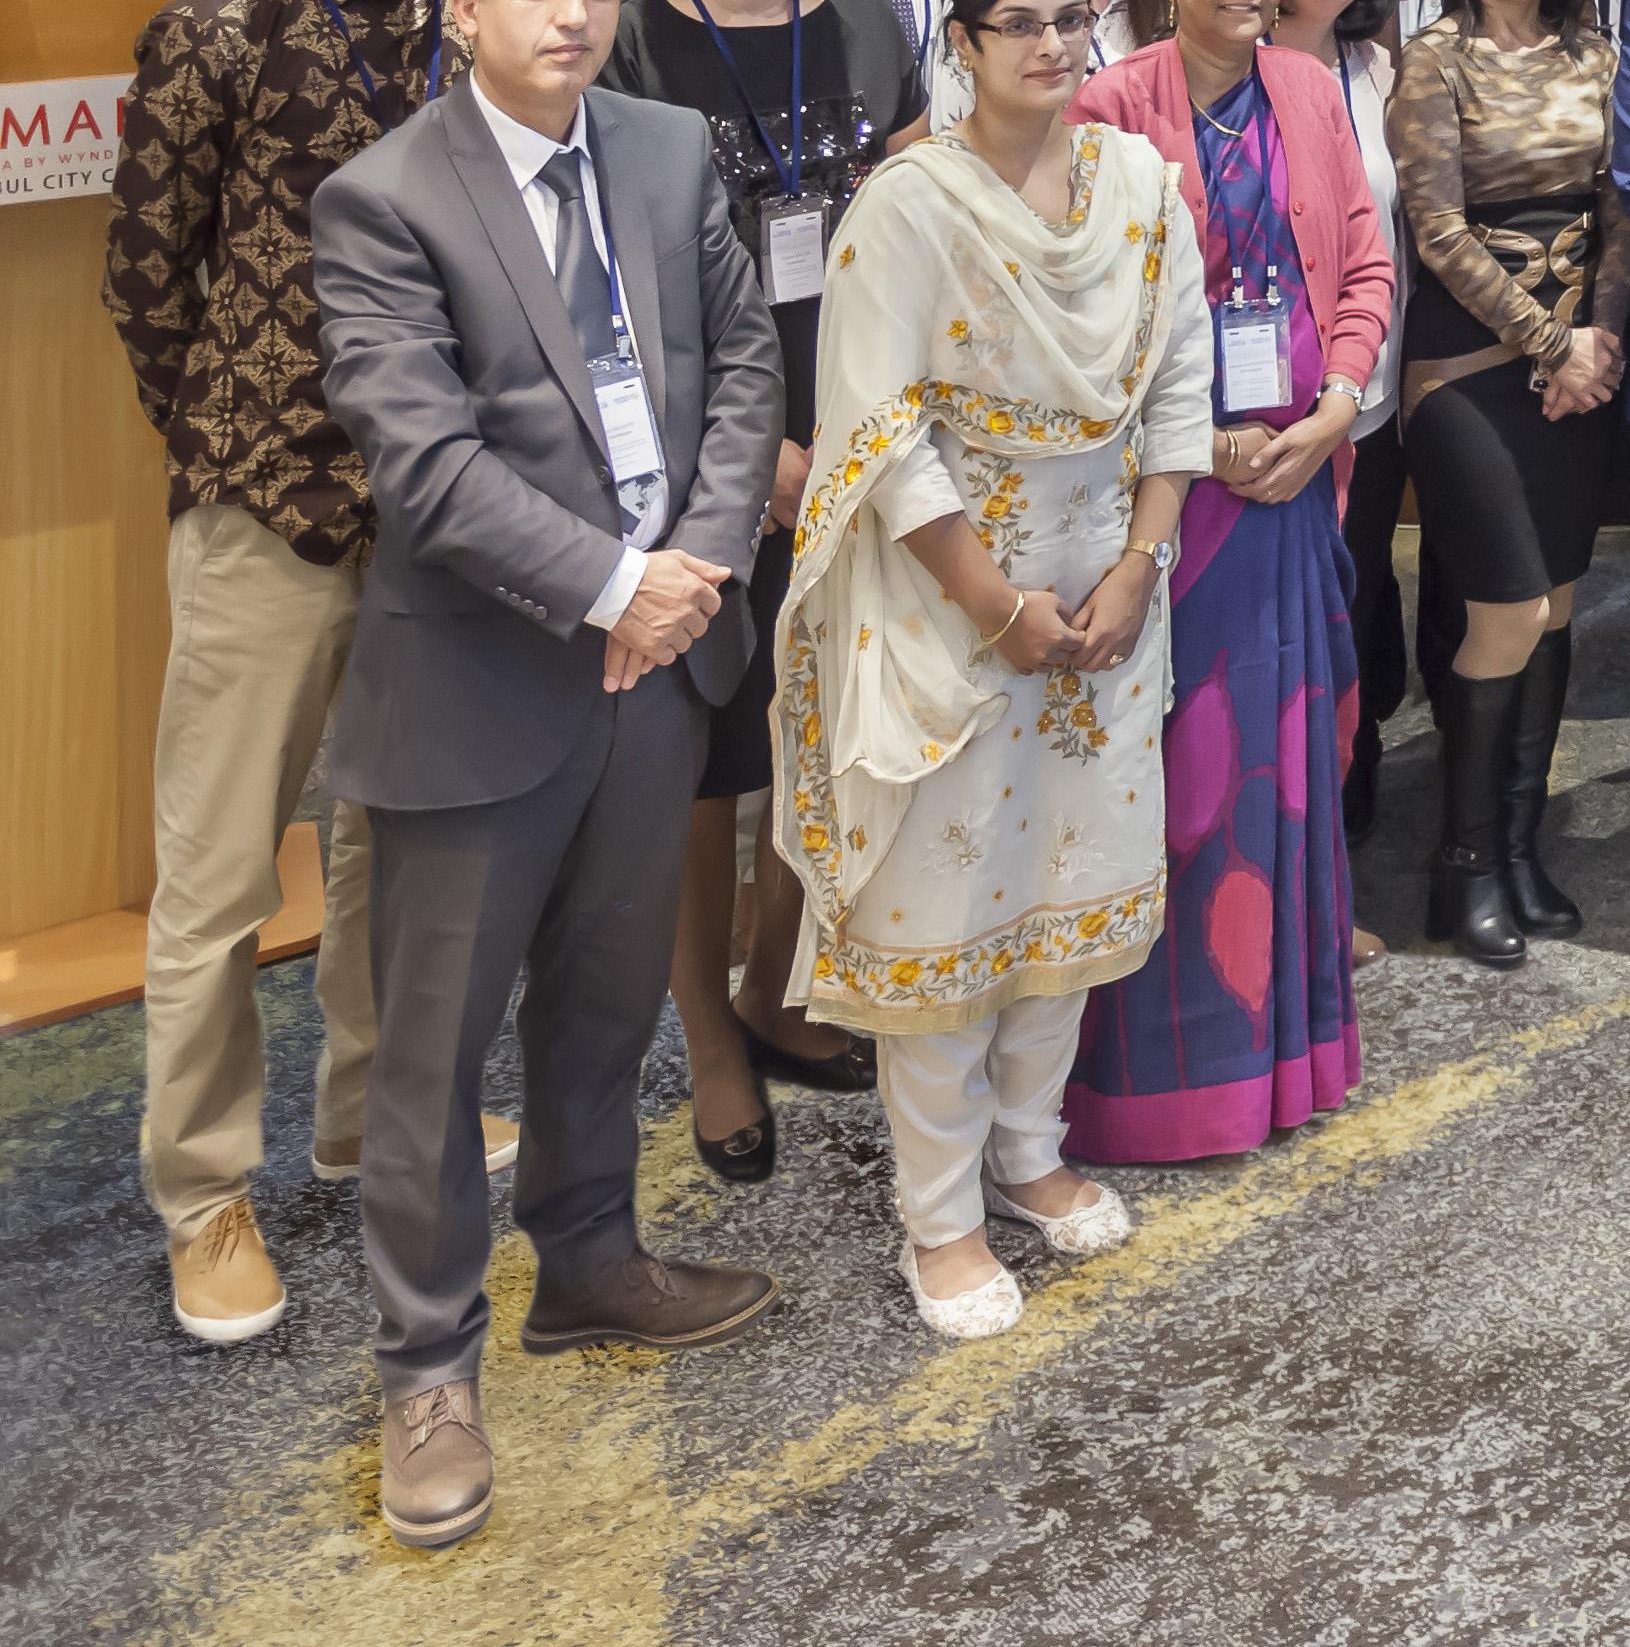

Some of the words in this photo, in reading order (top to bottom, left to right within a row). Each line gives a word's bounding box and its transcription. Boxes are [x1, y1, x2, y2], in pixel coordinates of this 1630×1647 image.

[24, 156, 47, 168] BY
[58, 149, 114, 164] WYND
[0, 177, 34, 194] UL
[43, 170, 92, 190] CITY
